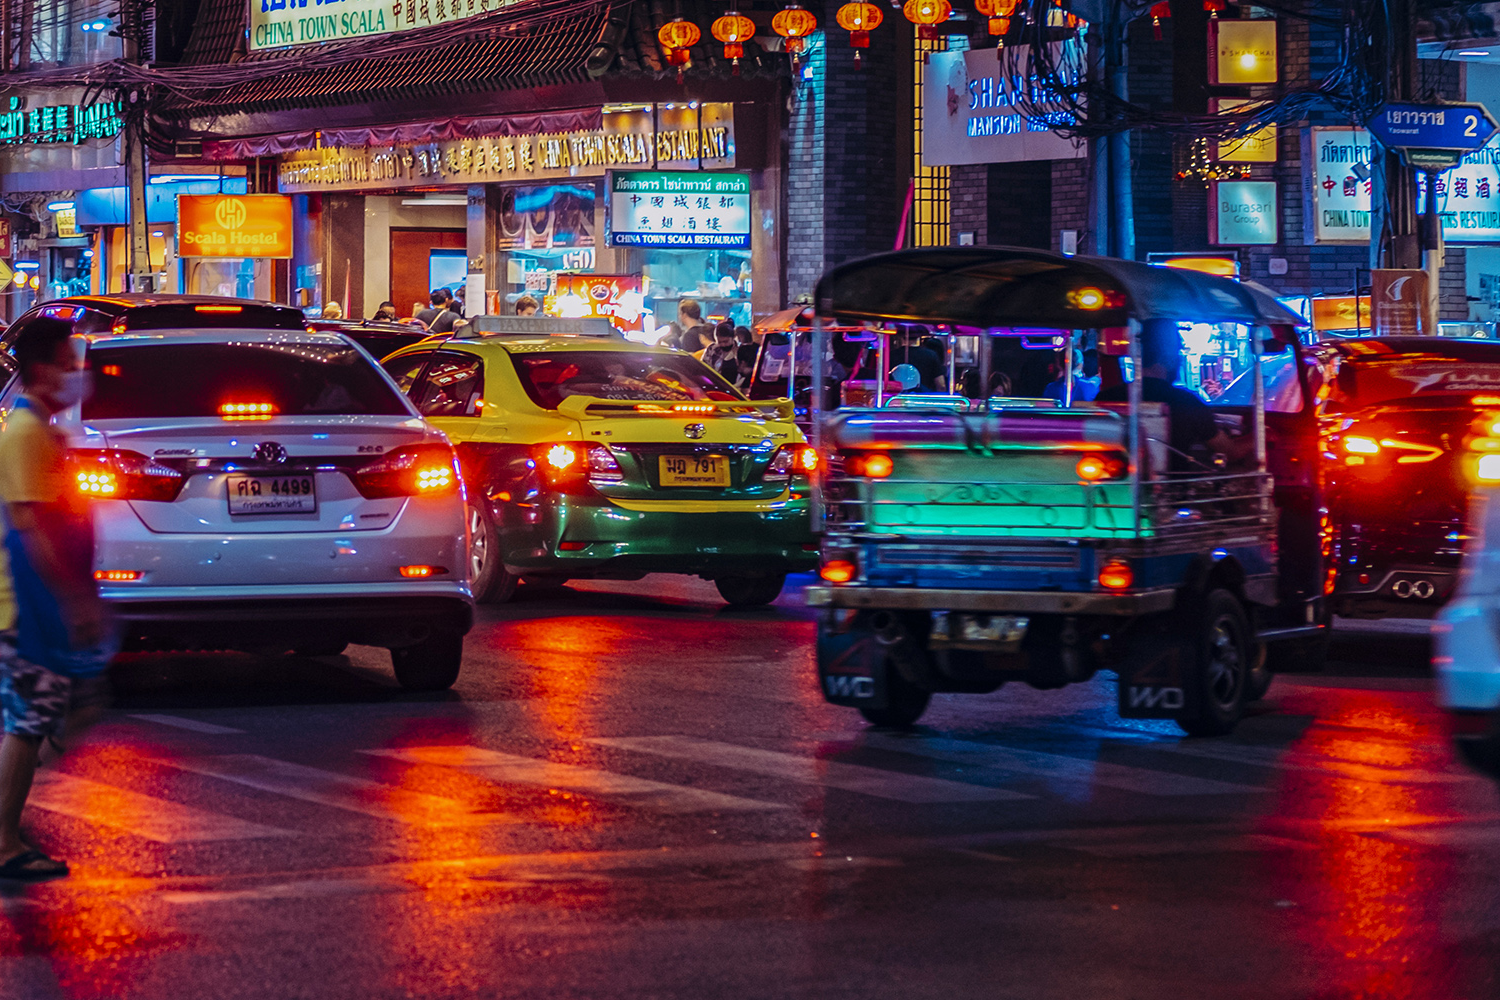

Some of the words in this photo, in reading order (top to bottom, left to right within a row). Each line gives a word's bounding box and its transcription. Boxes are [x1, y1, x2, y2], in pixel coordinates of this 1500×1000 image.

[255, 20, 294, 47] CHINA
[299, 14, 338, 41] TOWN
[340, 8, 386, 35] SCALA
[969, 70, 1079, 110] SHAN
[967, 114, 1021, 136] MANSION
[1387, 111, 1445, 125] เยาวราช
[1463, 115, 1478, 137] 2
[1388, 127, 1419, 135] Yaowarat
[537, 139, 571, 168] CHINA
[572, 135, 607, 166] TOWN
[608, 132, 647, 164] SCALA
[1321, 139, 1372, 163] ภัตตาคา
[616, 177, 660, 191] ภัตตาคาร
[661, 176, 711, 191] ไชน่าทาวน์
[715, 178, 746, 192] สกาล่า
[628, 194, 734, 210] 中國城銀都
[1221, 201, 1272, 213] Burasari
[1234, 215, 1260, 225] Group
[1323, 209, 1349, 228] CHINA
[1350, 210, 1372, 228] TOW
[184, 231, 226, 244] Scala
[230, 231, 278, 244] Hostel
[616, 234, 641, 244] CHINA
[642, 235, 666, 244] TOWN
[667, 235, 693, 244] SCALA
[694, 235, 746, 245] RESTAURANT
[693, 459, 717, 473] 791
[271, 478, 311, 496] 4499
